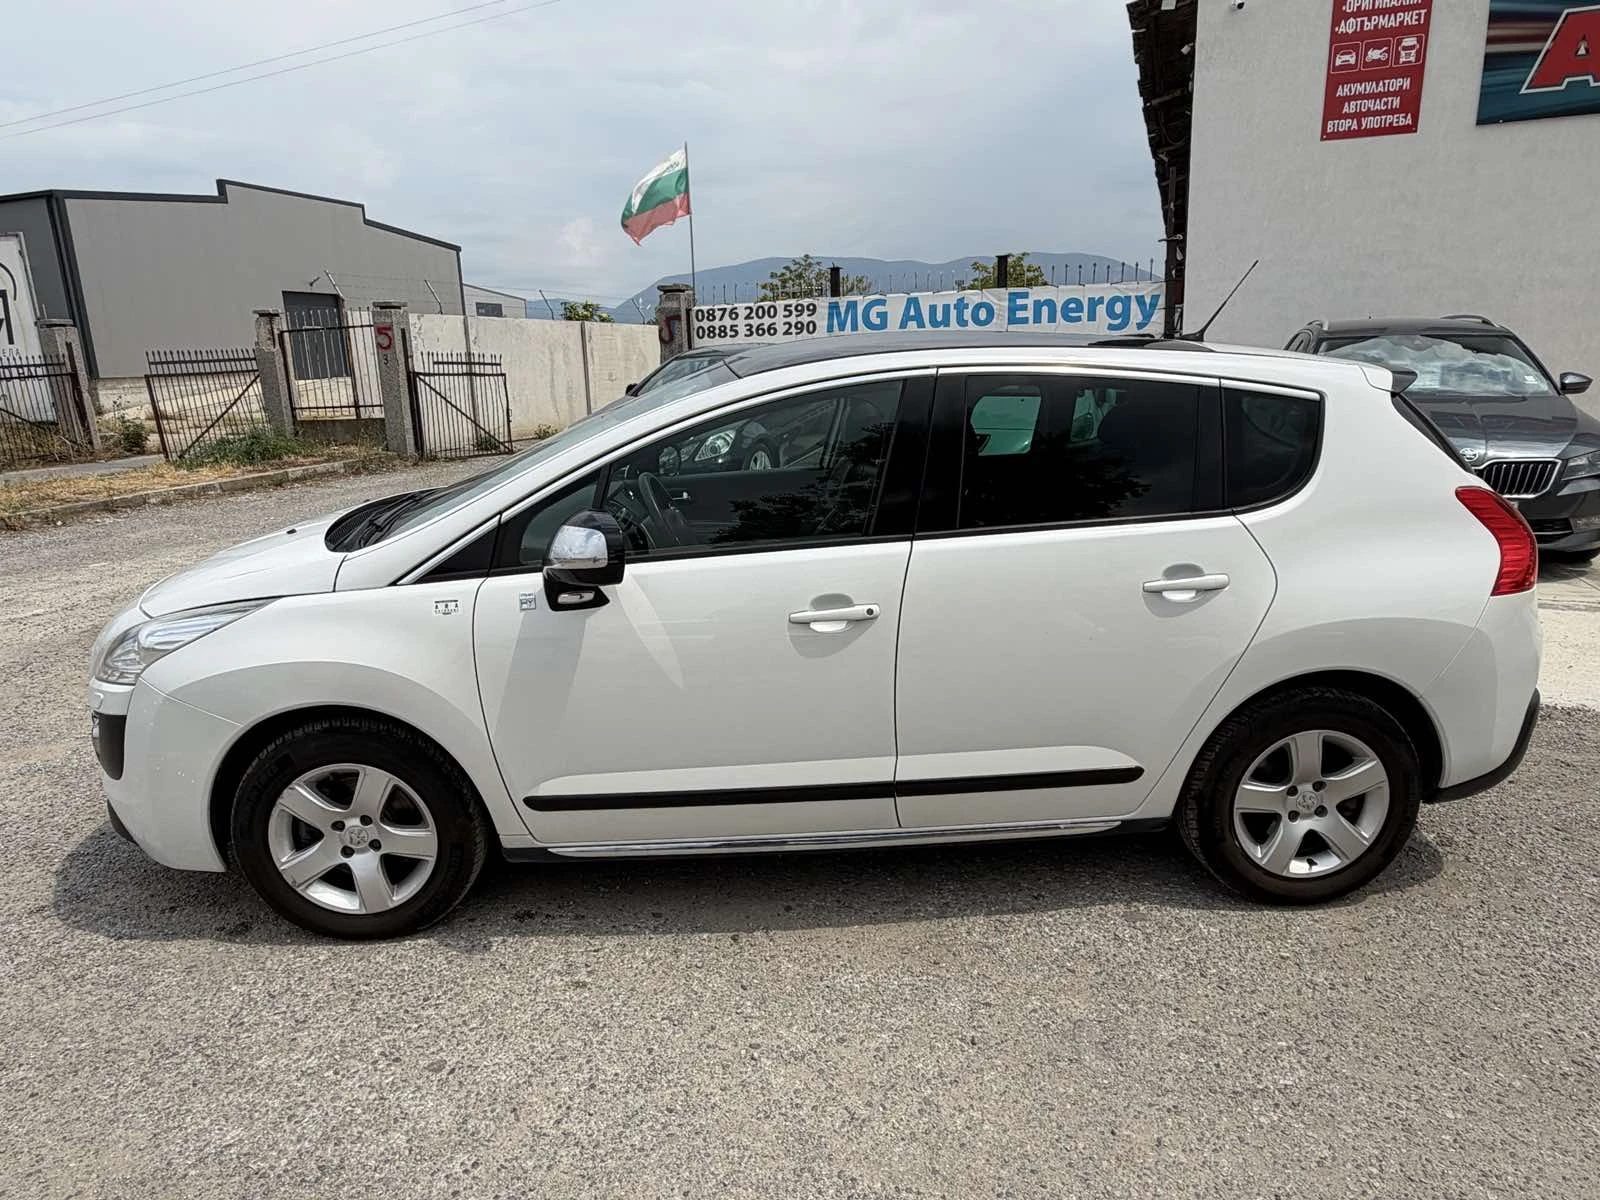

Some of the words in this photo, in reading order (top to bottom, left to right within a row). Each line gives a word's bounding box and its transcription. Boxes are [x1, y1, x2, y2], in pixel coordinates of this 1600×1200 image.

[1345, 0, 1423, 13] ОРИГИНА
[1337, 9, 1428, 34] АФТЪРМАРКЕТ
[1336, 77, 1411, 97] АКУМУЛАТОРИ
[1342, 96, 1400, 114] АВТОЧАСТИ
[1327, 117, 1358, 133] ВТОРА
[1360, 112, 1413, 130] УПОТРЕБА
[694, 307, 740, 322] 0876
[743, 304, 778, 320] 200
[782, 303, 817, 318] 599
[825, 299, 889, 334] MG
[898, 296, 995, 330] Auto
[1007, 291, 1161, 331] Energy
[376, 325, 393, 351] 5
[696, 324, 739, 340] 0885
[743, 322, 778, 337] 366
[782, 320, 817, 336] 290
